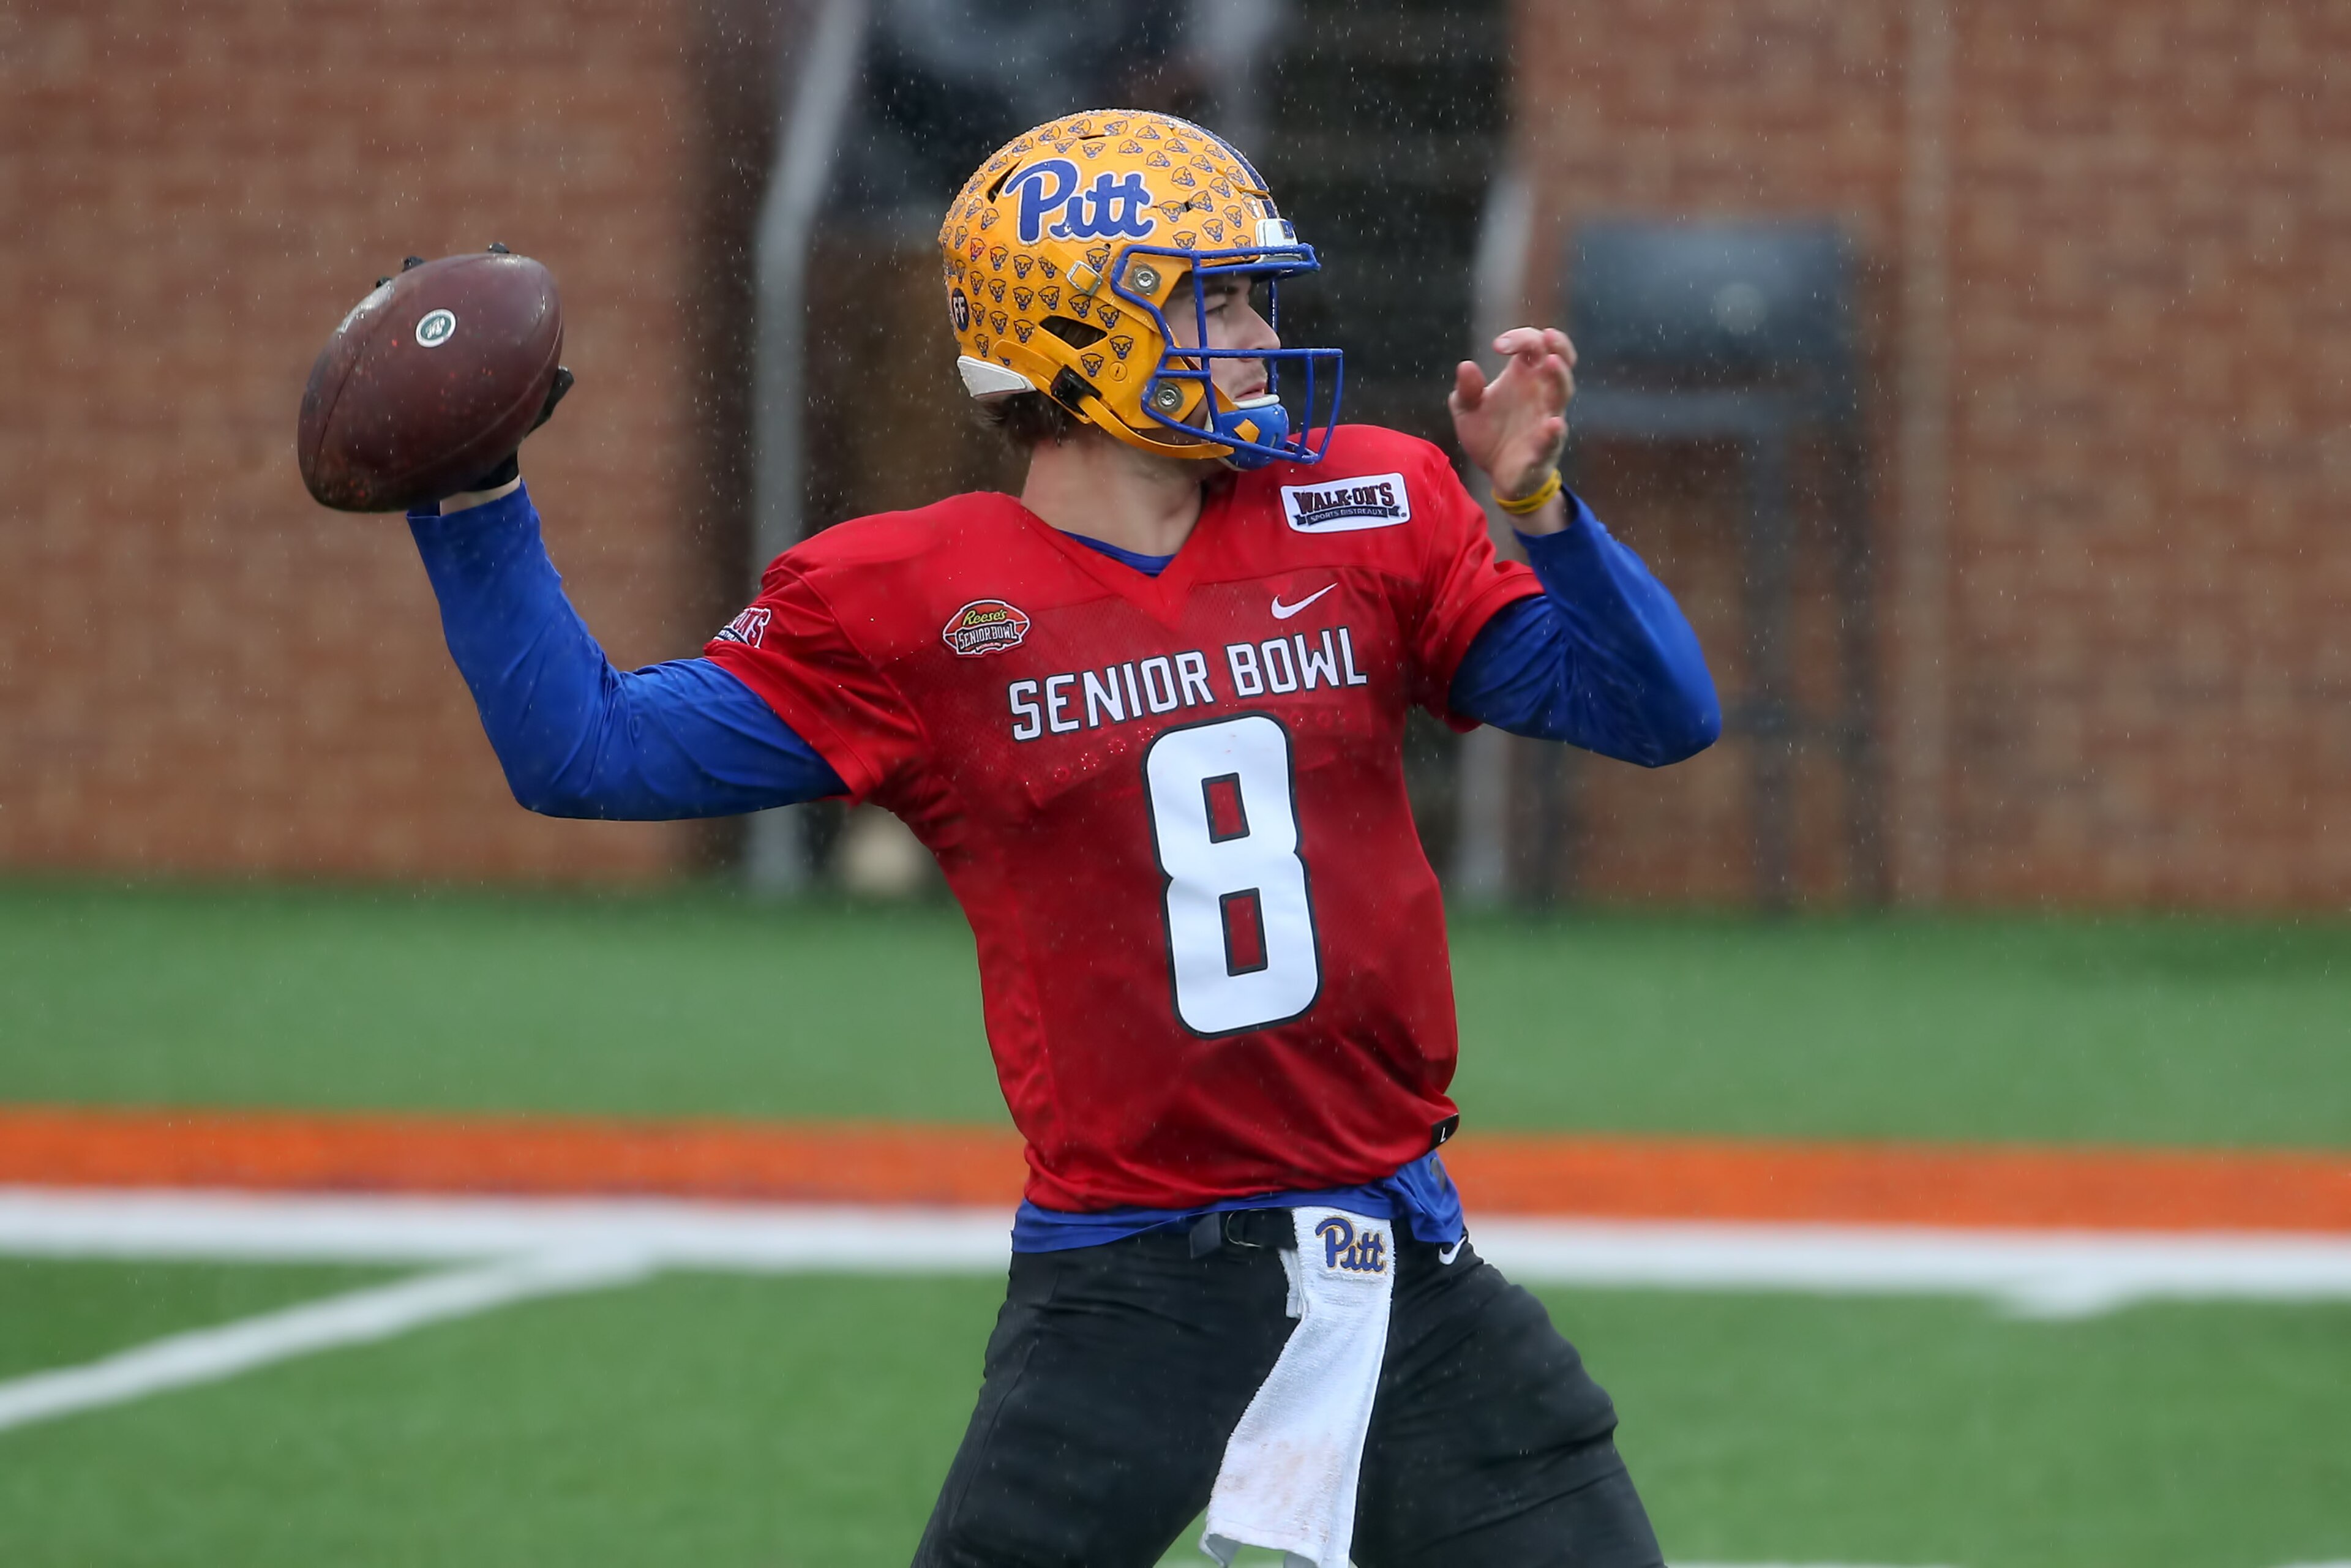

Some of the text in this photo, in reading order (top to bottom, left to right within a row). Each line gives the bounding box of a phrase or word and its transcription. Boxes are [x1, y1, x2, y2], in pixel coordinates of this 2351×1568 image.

[1003, 157, 1156, 244] Pitt
[1310, 510, 1340, 522] SPORTS
[958, 626, 992, 650] SENIOR
[992, 623, 1018, 640] BOWL
[962, 609, 1007, 626] Reese's
[1008, 626, 1368, 741] SENIOR BOWL
[1143, 712, 1322, 1037] 8
[1314, 1215, 1387, 1275] Pitt
